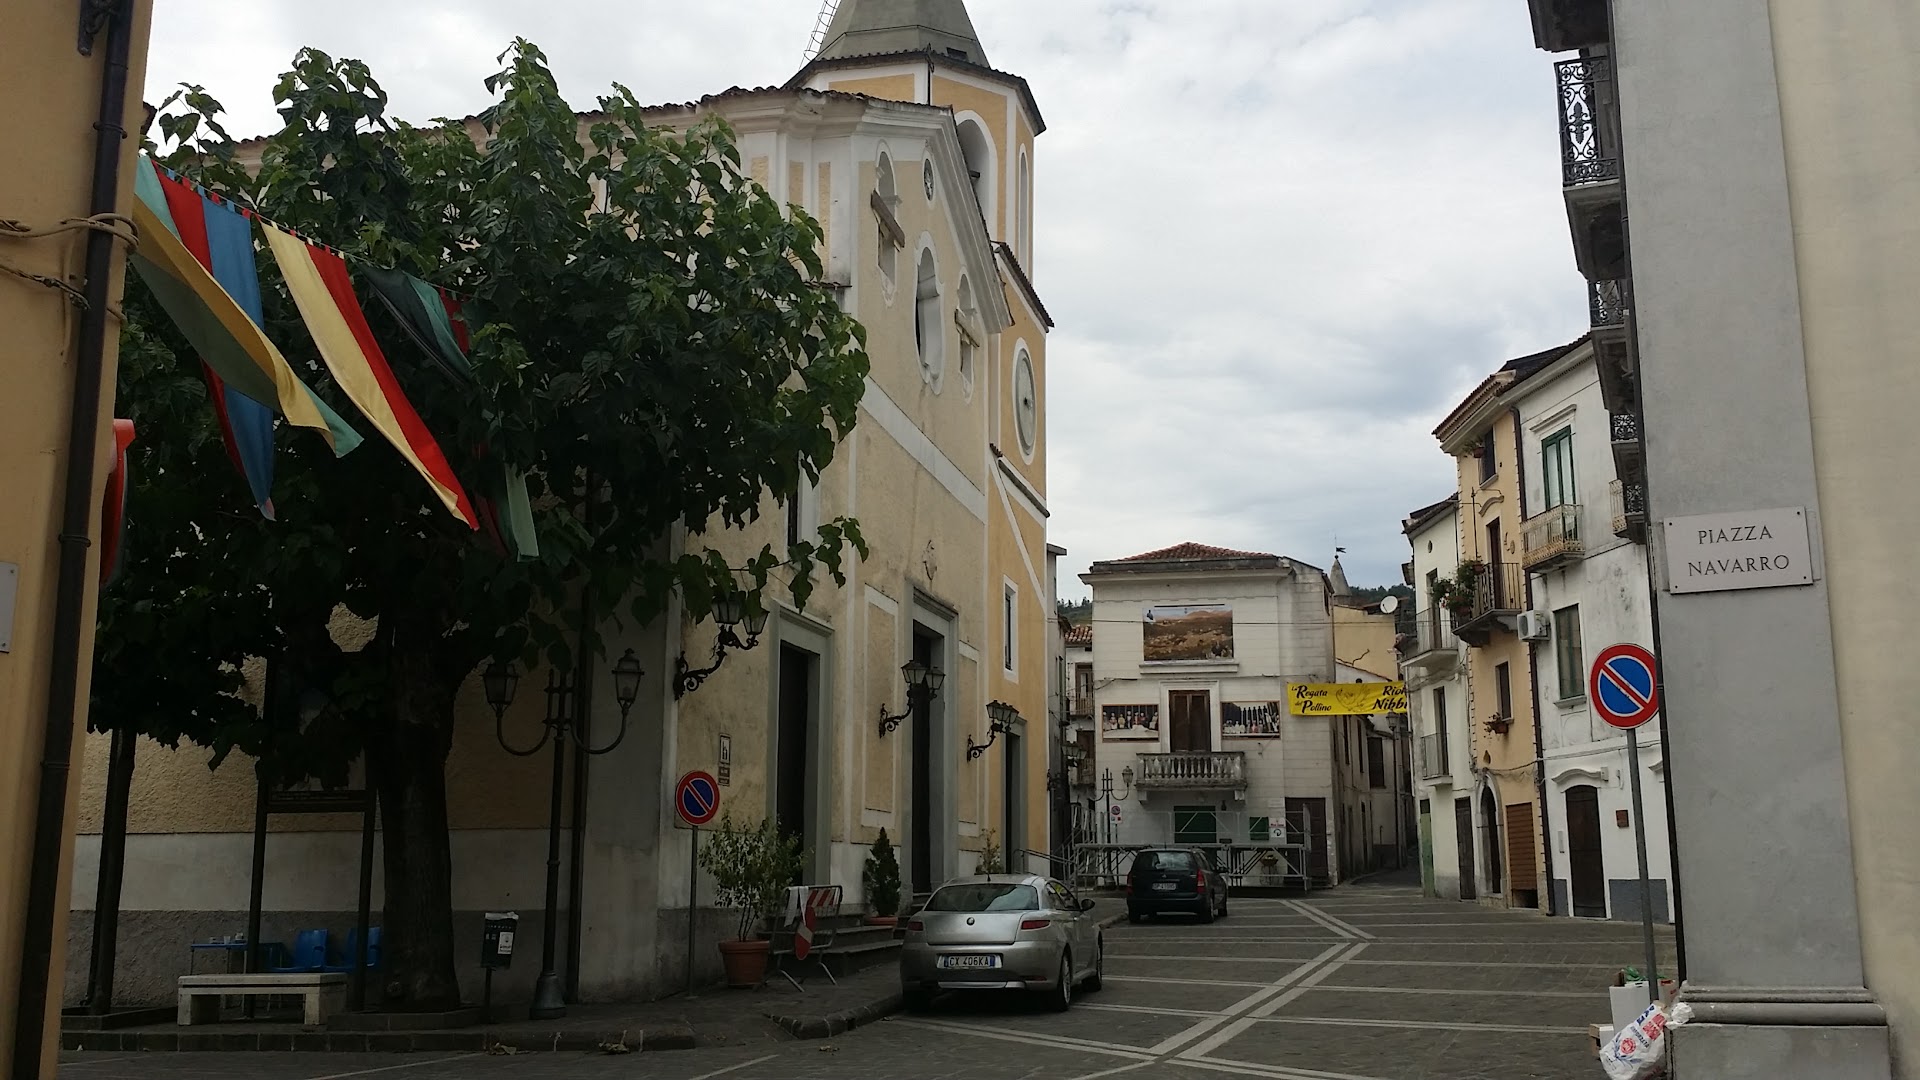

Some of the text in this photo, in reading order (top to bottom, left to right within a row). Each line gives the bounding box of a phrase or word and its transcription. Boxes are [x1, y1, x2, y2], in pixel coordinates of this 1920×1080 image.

[1698, 525, 1773, 545] PIAZZA
[1688, 554, 1790, 577] NAVARRO
[1296, 685, 1328, 699] Regata
[1301, 700, 1332, 713] Pollino
[949, 956, 989, 966] CX 406KA
